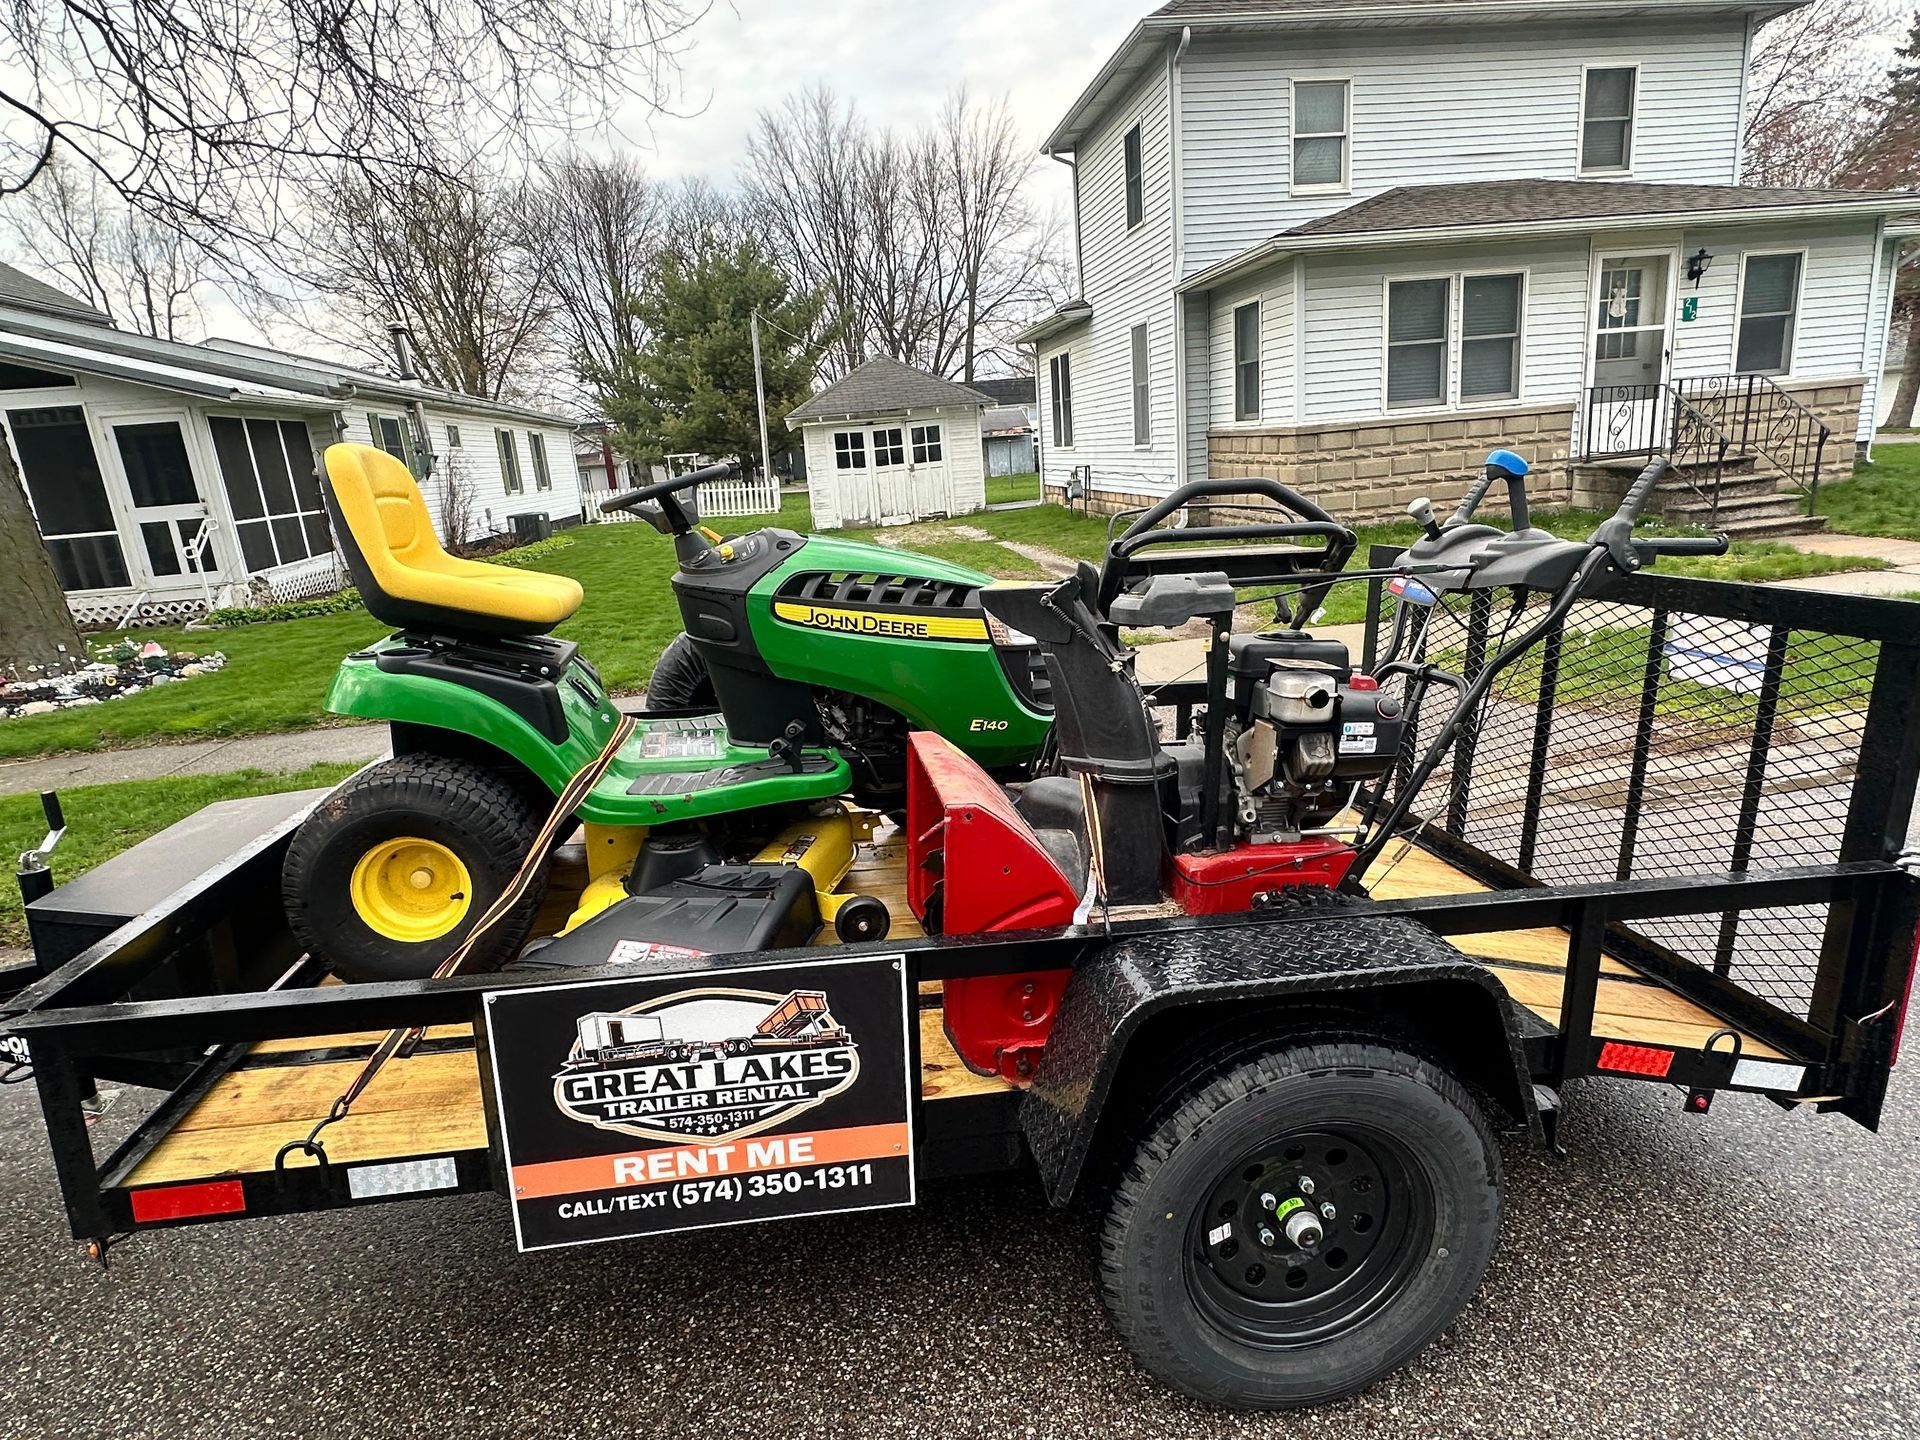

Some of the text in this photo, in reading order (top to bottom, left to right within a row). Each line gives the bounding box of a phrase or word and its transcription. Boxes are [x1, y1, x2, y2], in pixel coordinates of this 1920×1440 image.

[803, 608, 928, 636] JOHN DEERE
[969, 719, 1009, 731] E140
[563, 1051, 852, 1102] GREAT LAKES
[603, 1083, 810, 1118] TRAILER RENTAL
[669, 1109, 755, 1128] 574-350-1311
[613, 1136, 816, 1184] RENT ME
[558, 1163, 873, 1219] CALL/TEXT (574) 350-1311
